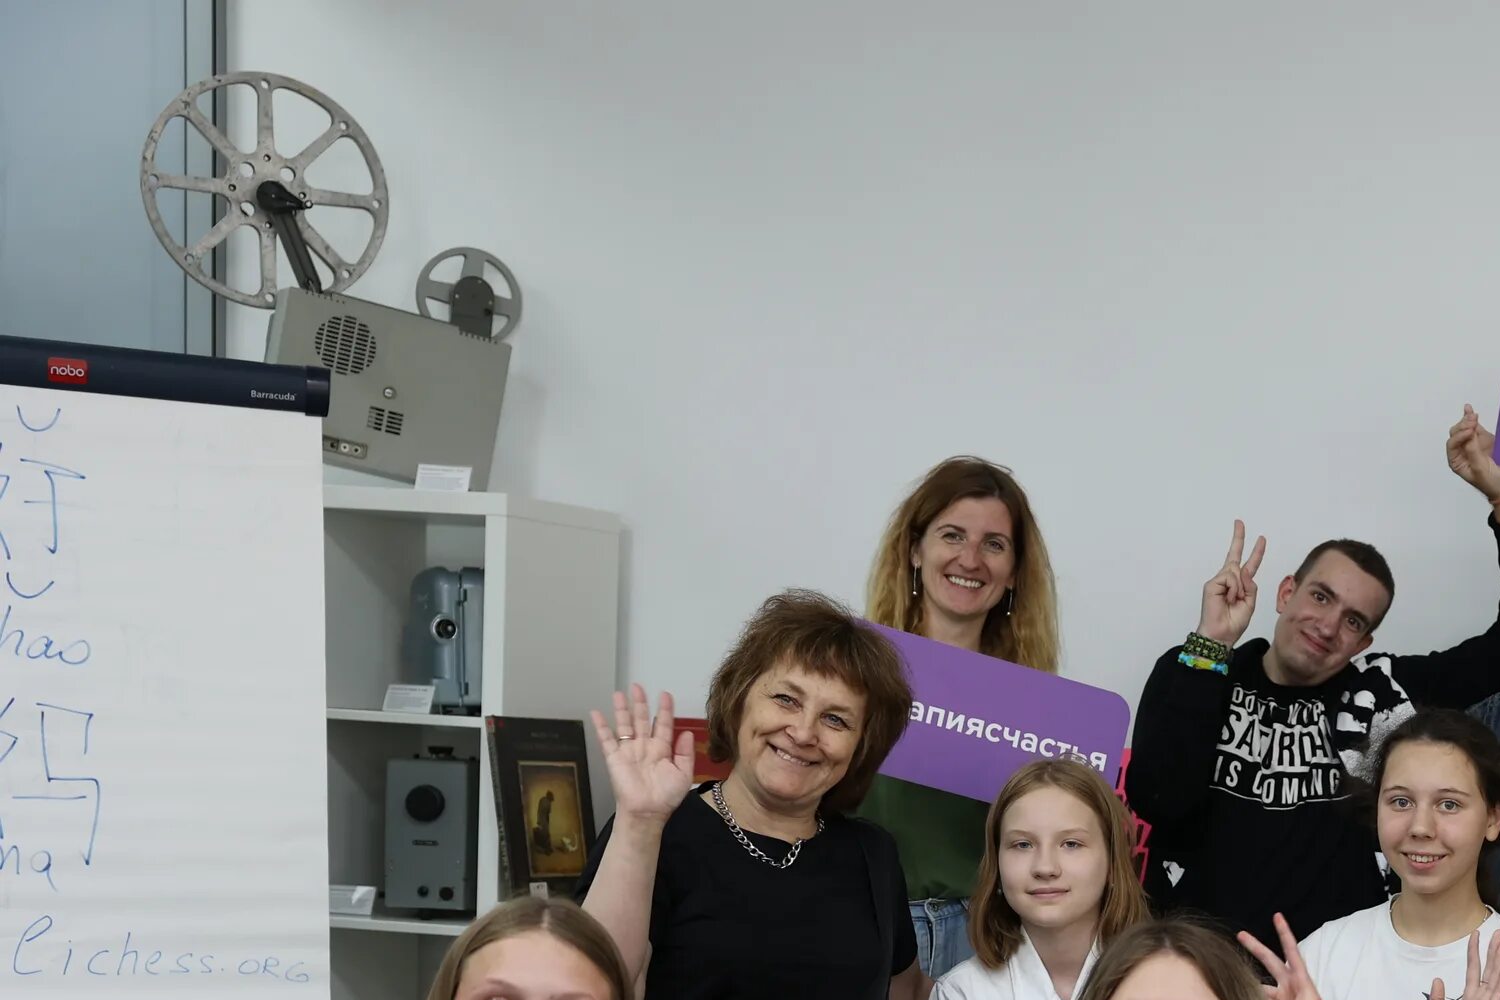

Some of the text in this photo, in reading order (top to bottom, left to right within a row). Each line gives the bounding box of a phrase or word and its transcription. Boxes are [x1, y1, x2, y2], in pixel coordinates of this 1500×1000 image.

[50, 363, 85, 378] nobo
[250, 389, 296, 401] Barracuda
[906, 700, 1108, 772] апиясчастья
[1213, 755, 1243, 788] IS
